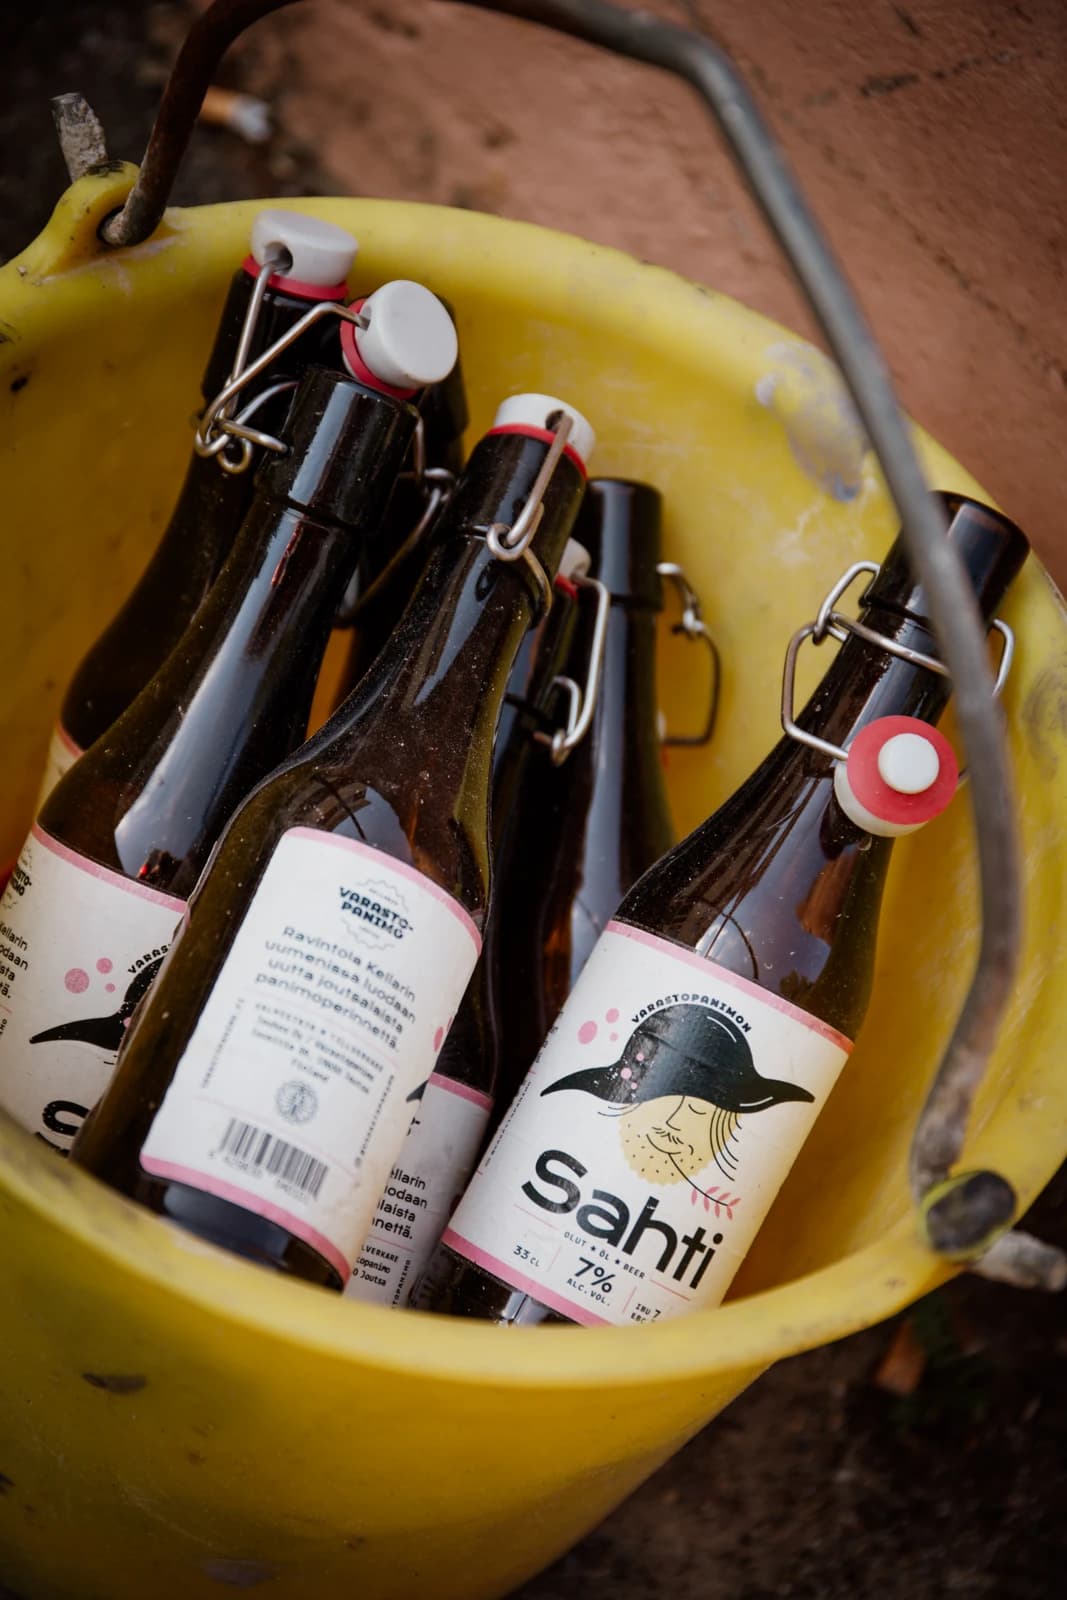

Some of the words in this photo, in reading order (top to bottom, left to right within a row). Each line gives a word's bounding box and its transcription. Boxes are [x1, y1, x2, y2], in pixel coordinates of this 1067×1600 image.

[341, 901, 404, 939] PANIMO
[127, 944, 171, 974] VARAS
[283, 926, 361, 966] Ravintola
[366, 961, 416, 1002] Kellarin
[265, 940, 360, 984] uumenissa
[364, 978, 416, 1023] luodaan
[268, 958, 313, 981] uutta
[318, 976, 403, 1033] joutsalaista
[632, 993, 752, 1032] VARASTOPANIMON
[521, 1149, 724, 1290] Sahti
[513, 1245, 530, 1260] 33
[564, 1231, 587, 1247] OLUT
[623, 1263, 646, 1280] BEER
[575, 1257, 616, 1293] 7%
